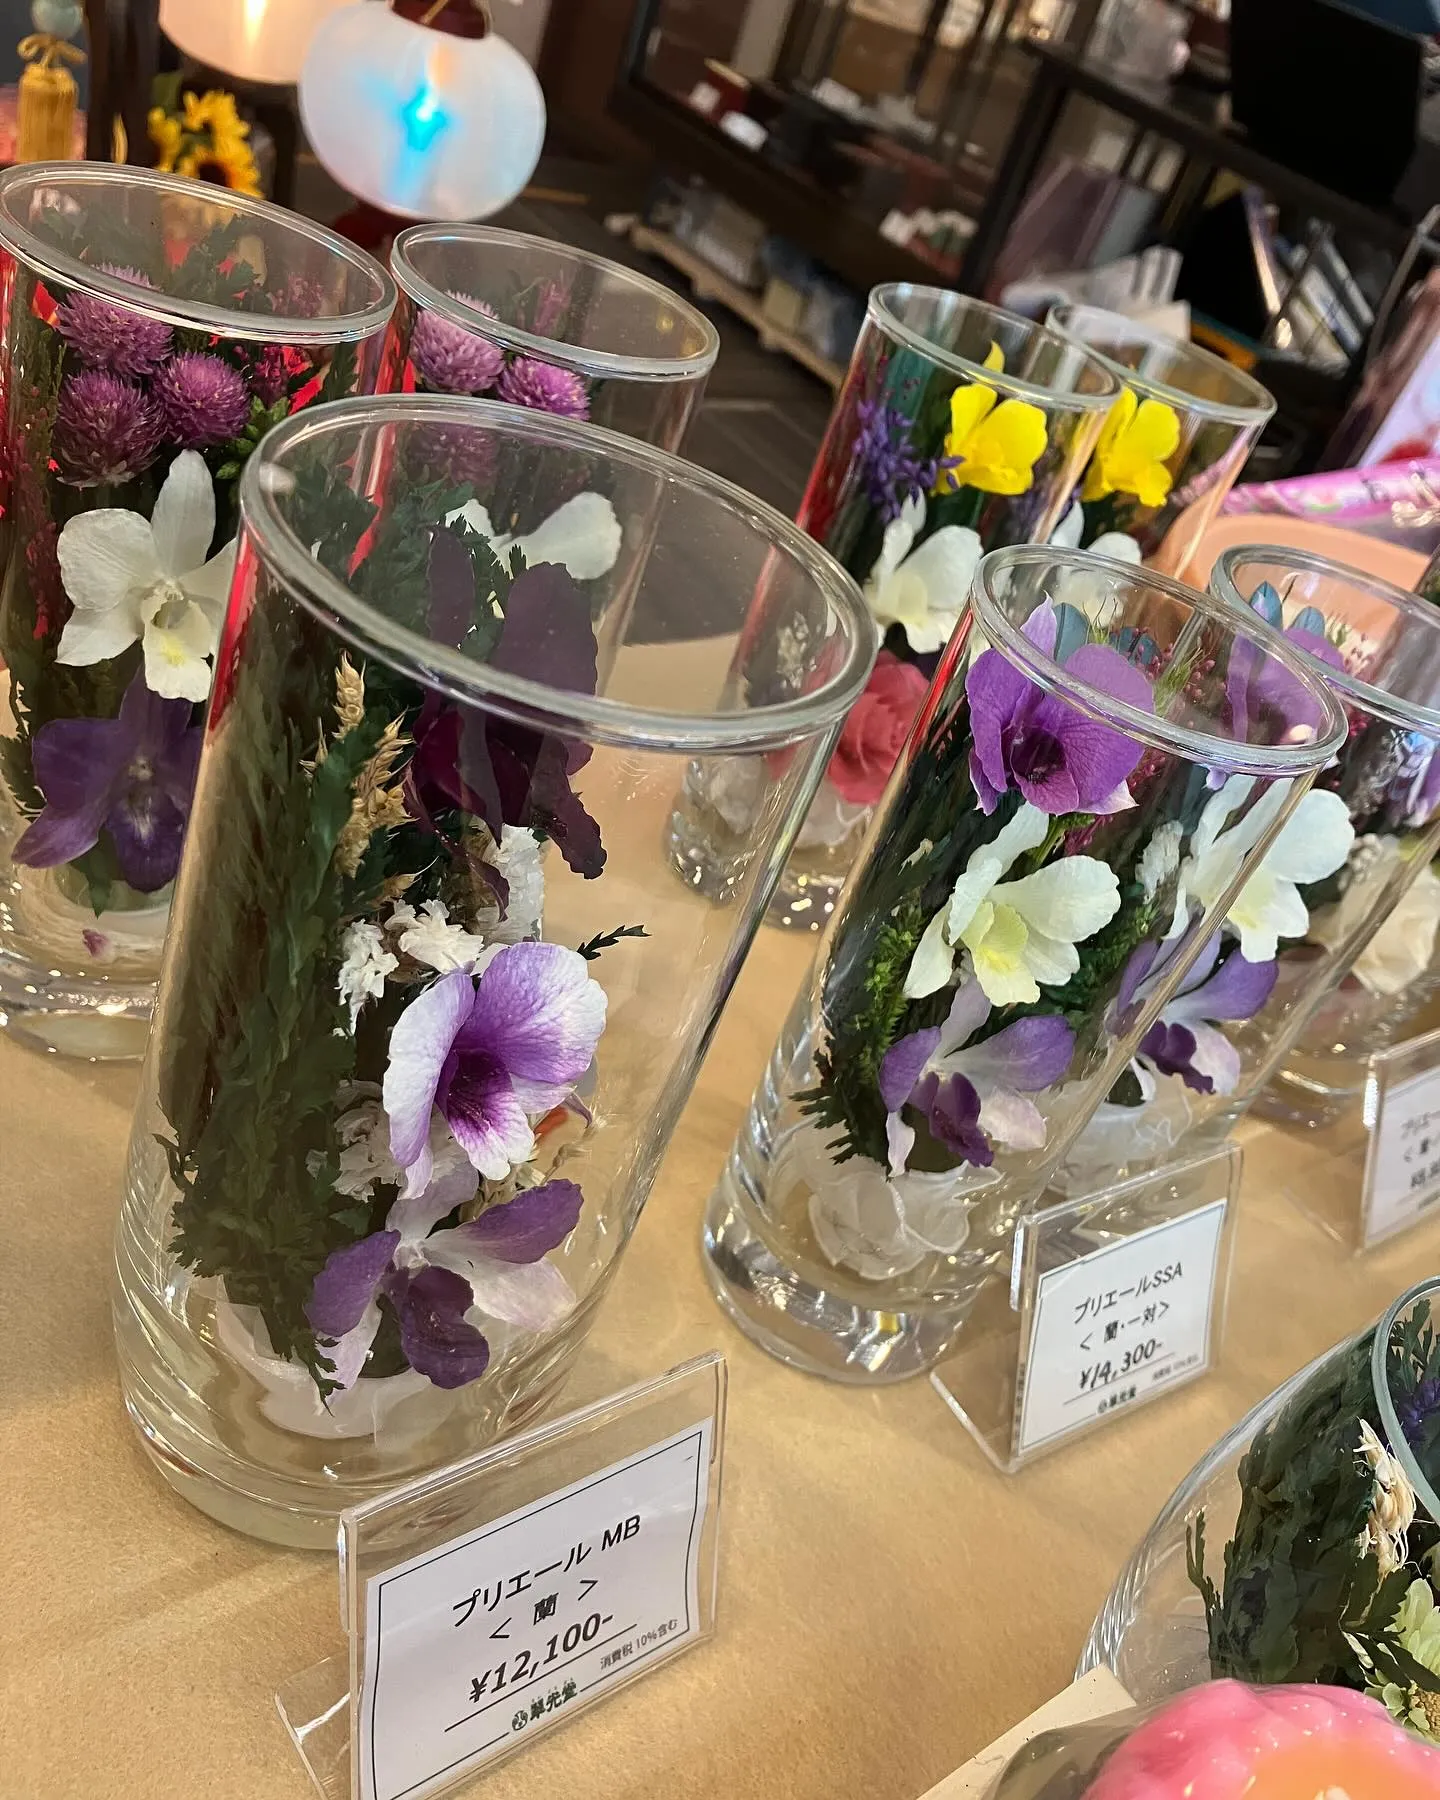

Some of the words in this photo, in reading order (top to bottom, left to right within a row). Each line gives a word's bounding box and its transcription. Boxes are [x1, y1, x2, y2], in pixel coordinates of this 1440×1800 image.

[452, 1541, 593, 1628] プリエール
[600, 1513, 642, 1552] MB
[468, 1611, 614, 1704] ¥12,100-
